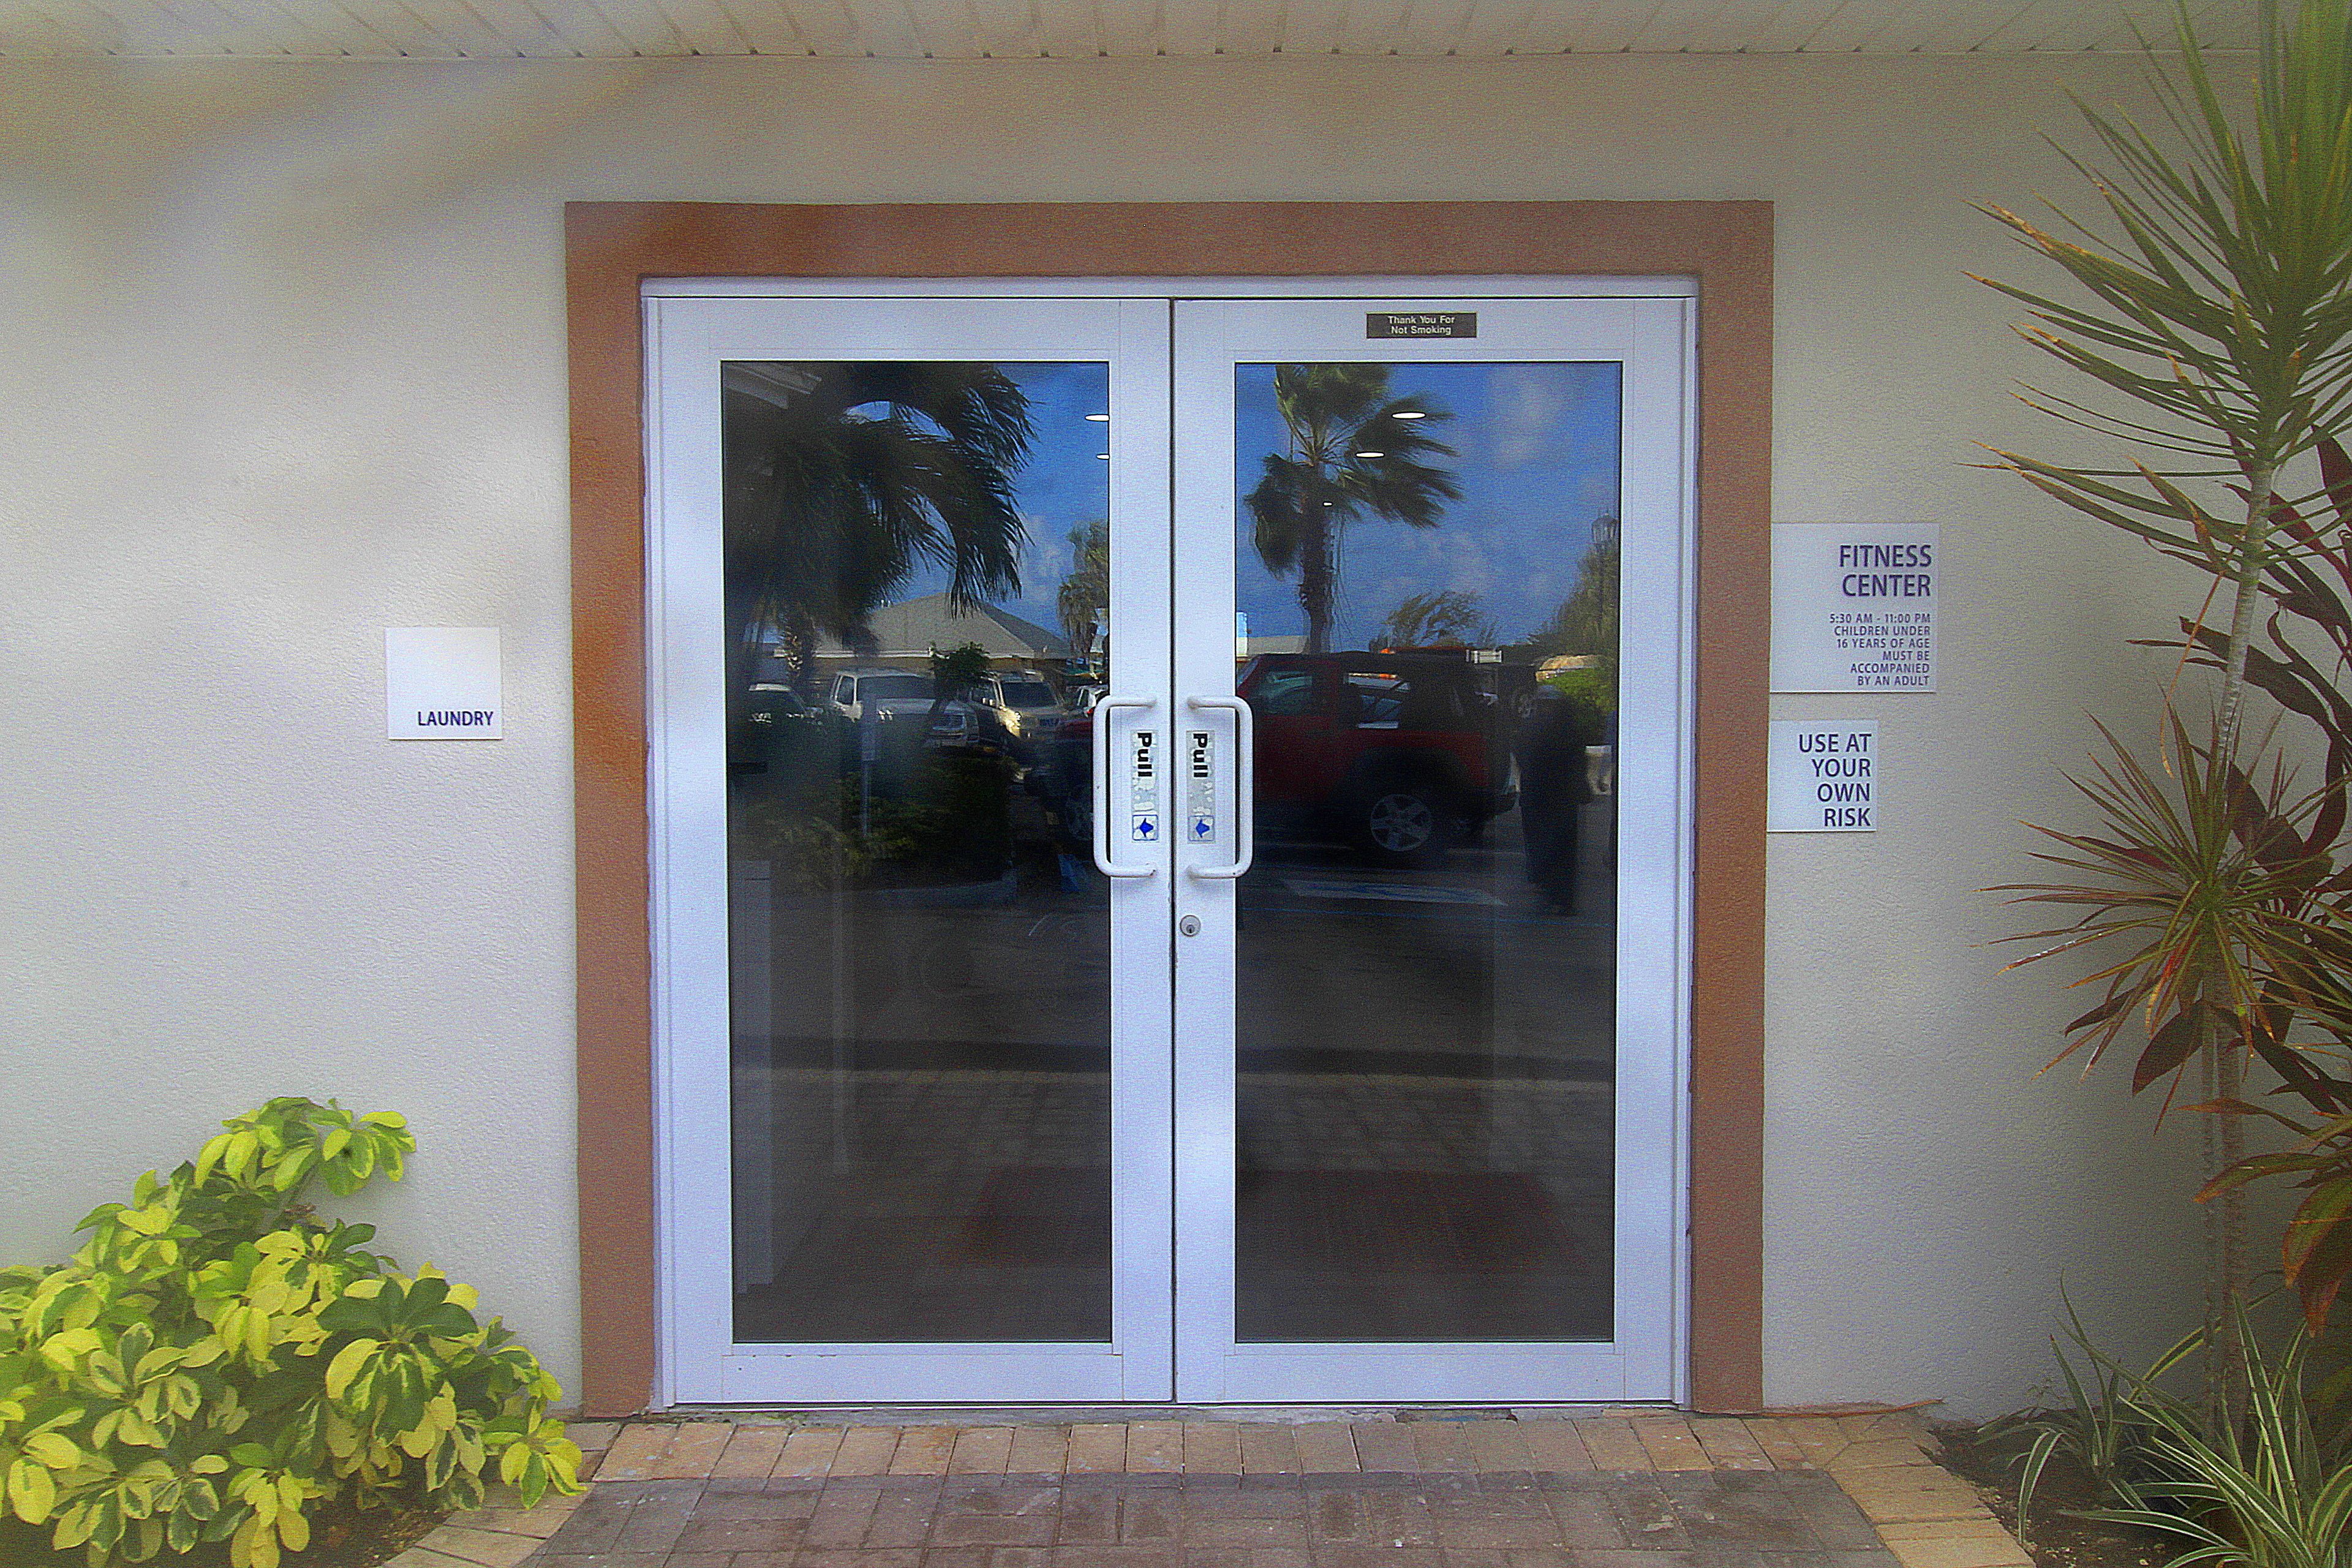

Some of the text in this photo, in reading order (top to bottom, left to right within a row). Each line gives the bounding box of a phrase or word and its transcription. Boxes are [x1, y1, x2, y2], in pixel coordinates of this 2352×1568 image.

[1411, 326, 1452, 335] Smoking
[1839, 545, 1932, 567] FITNESS
[1842, 575, 1931, 597] CENTER
[1830, 614, 1852, 623] 5:30
[1856, 614, 1872, 623] AM
[1885, 614, 1910, 623] 11:00
[1915, 614, 1930, 623] PM
[1834, 626, 1930, 635] CHILDREN UNDER
[1838, 639, 1930, 648] 16 YEARS OF AGE
[1883, 650, 1929, 660] MUST BE
[1850, 663, 1929, 673] ACCOMPANIED
[1858, 676, 1929, 685] BY AN ADULT
[418, 711, 494, 726] LAUNDRY
[1799, 734, 1872, 752] USE AT
[1137, 733, 1152, 777] Pull
[1193, 733, 1208, 778] Pull
[1812, 758, 1871, 777] YOUR
[1817, 783, 1870, 802] OWN
[1825, 808, 1871, 826] RISK
